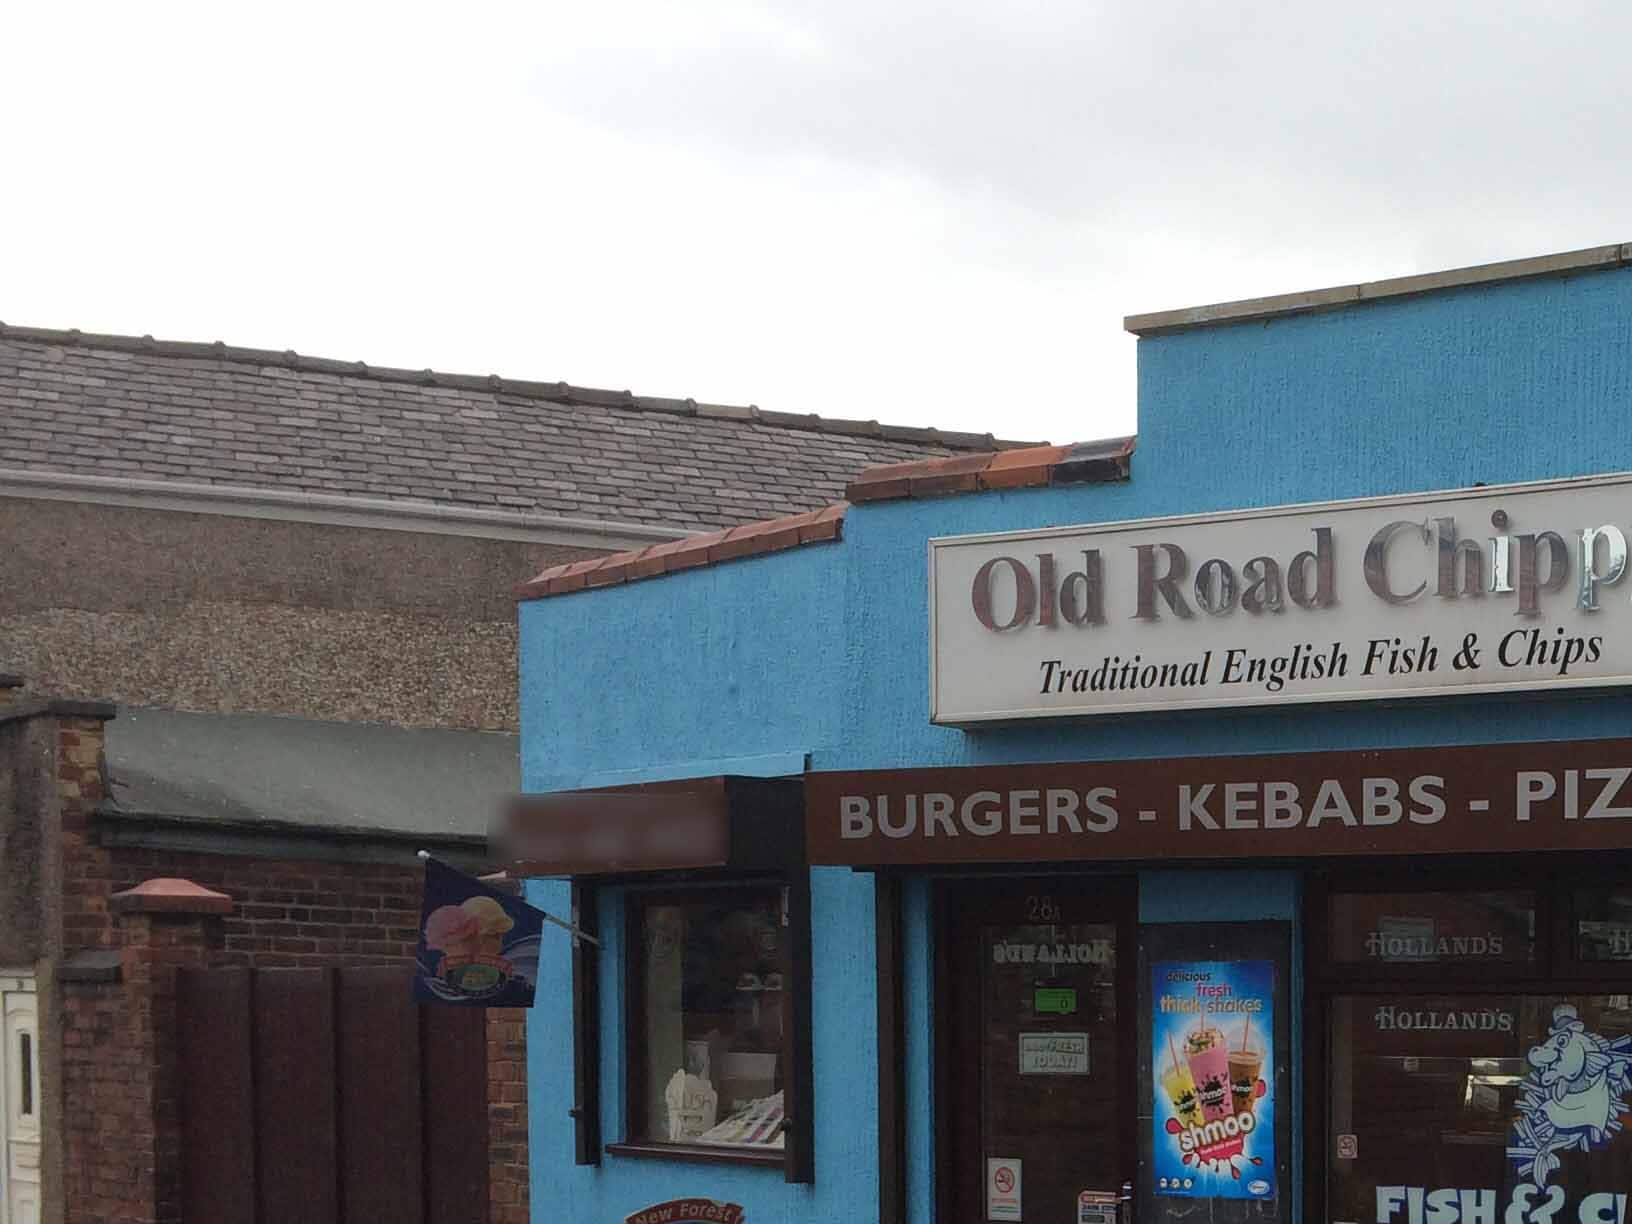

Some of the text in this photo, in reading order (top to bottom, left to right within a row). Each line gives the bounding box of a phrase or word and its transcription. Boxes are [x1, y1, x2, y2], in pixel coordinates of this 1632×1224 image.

[971, 548, 1108, 632] Old
[1131, 527, 1336, 622] Road
[1038, 625, 1603, 696] Traditional English Fish & Chips
[840, 787, 1119, 840] BURGERS
[1178, 775, 1446, 832] KEBABS
[1167, 969, 1211, 982] delicious
[1196, 982, 1232, 997] fresh
[1207, 997, 1264, 1013] shakes
[1180, 1111, 1256, 1151] shmoo
[680, 1203, 734, 1223] Forest
